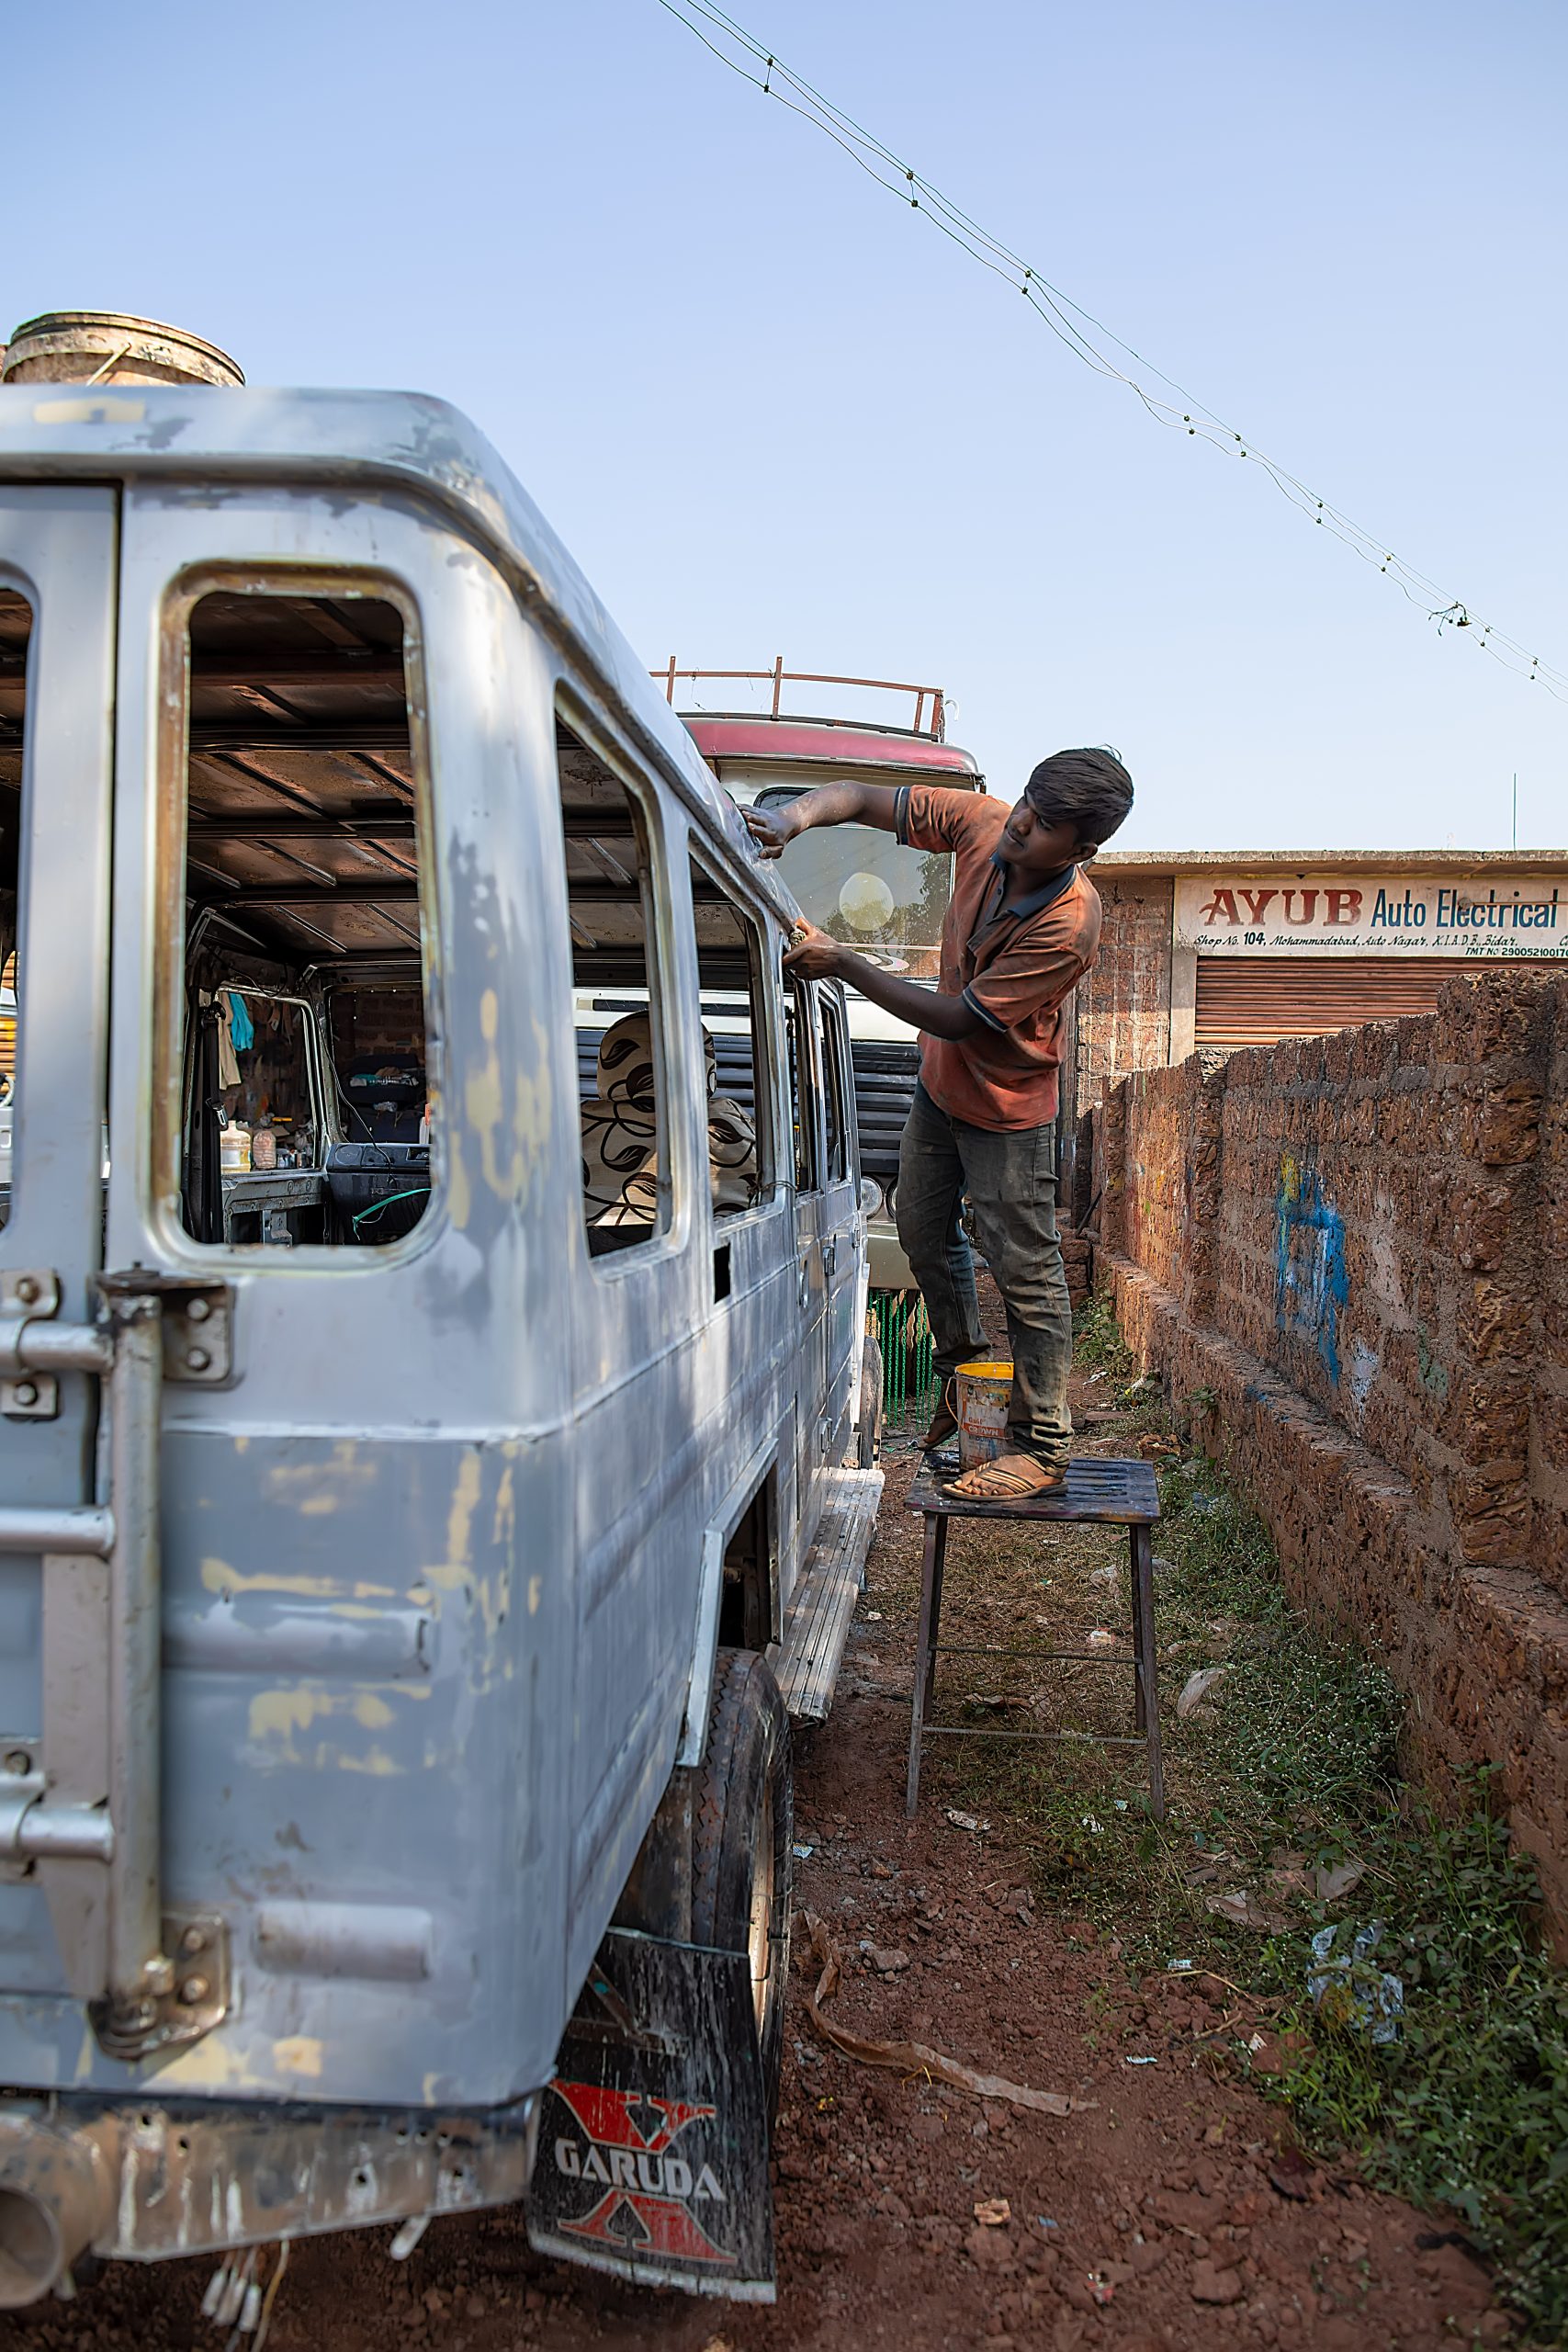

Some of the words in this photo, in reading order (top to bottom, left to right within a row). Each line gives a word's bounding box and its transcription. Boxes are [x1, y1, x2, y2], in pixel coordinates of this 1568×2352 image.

[1199, 888, 1363, 926] AYUB
[1371, 888, 1427, 927] Auto
[1436, 888, 1559, 927] Electrical
[1193, 934, 1222, 948] Shop
[1244, 932, 1267, 947] 104,
[1269, 934, 1360, 947] Mohammadabad,
[1361, 935, 1387, 946] Auto
[1388, 934, 1429, 949] Nagar,
[554, 2137, 727, 2203] GARUDA
